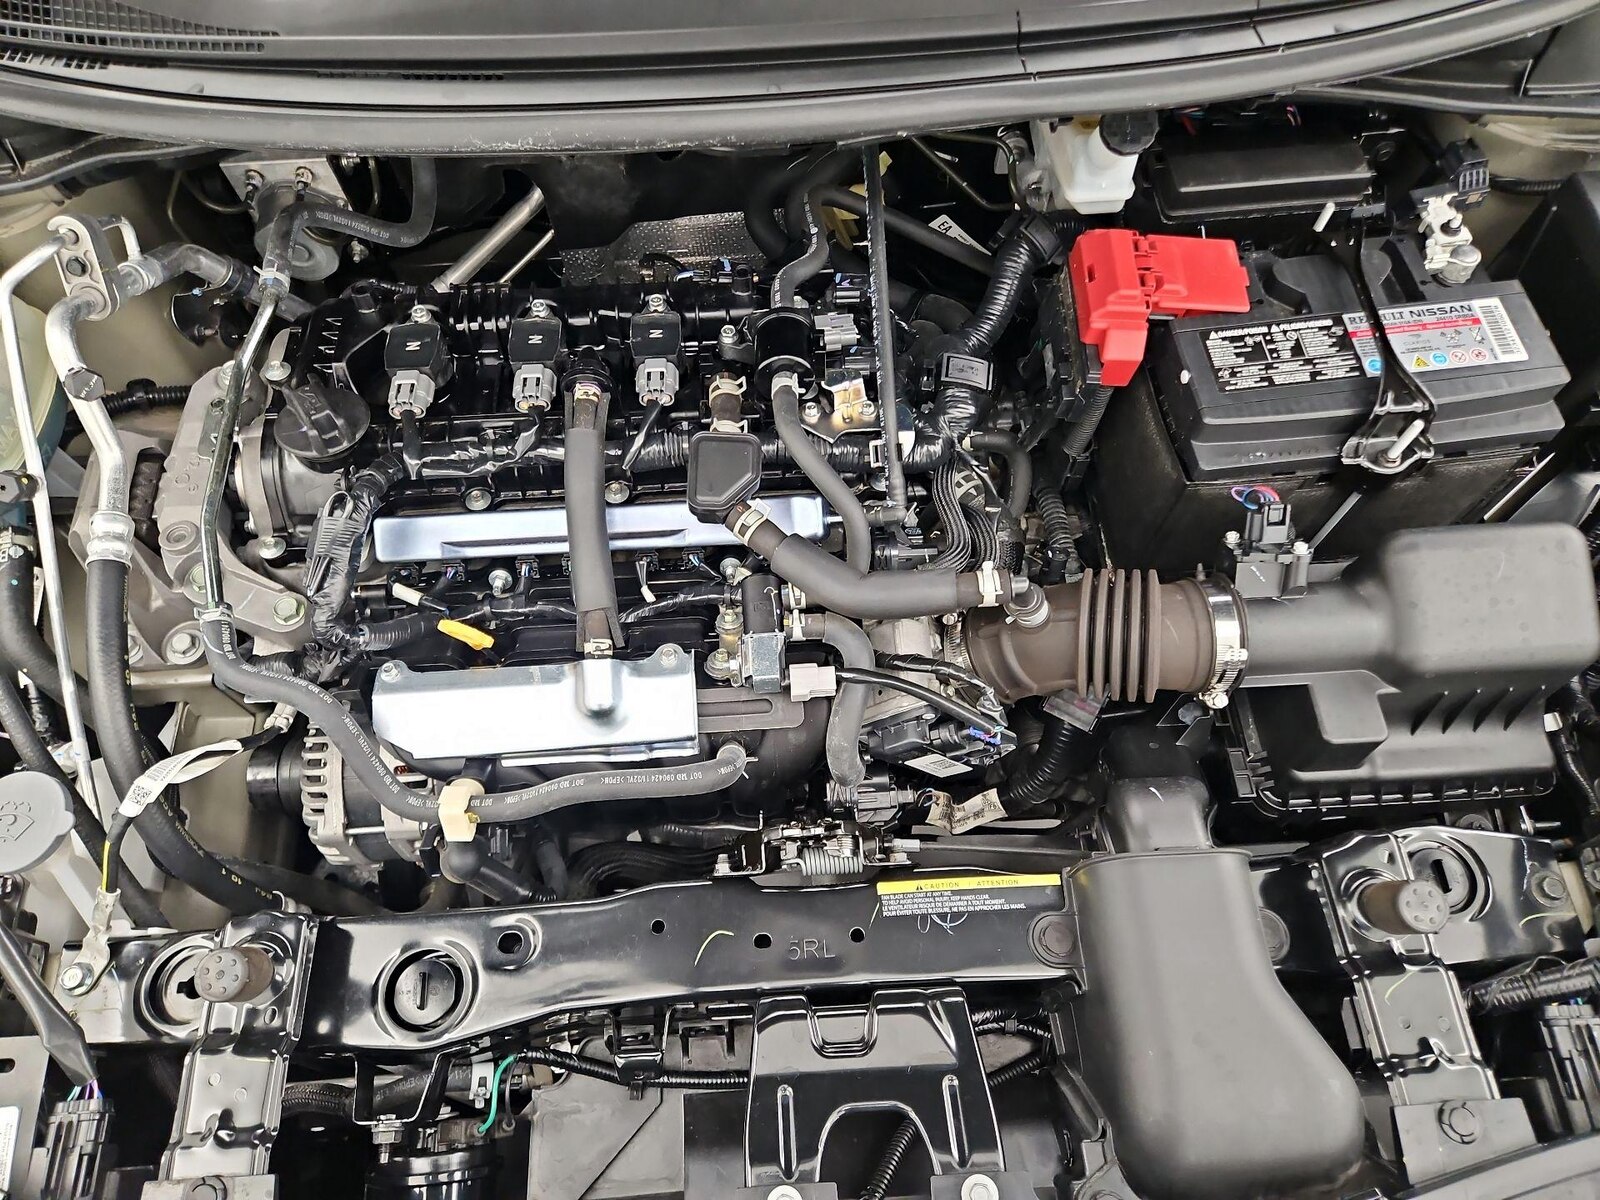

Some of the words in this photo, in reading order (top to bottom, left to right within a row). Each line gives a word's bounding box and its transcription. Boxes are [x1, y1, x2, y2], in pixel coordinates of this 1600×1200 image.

[937, 220, 953, 234] EA
[1349, 310, 1405, 326] REULT
[1409, 304, 1474, 318] NISSAN
[651, 773, 674, 782] 090424
[690, 771, 703, 780] DOT
[571, 778, 585, 787] DOT
[481, 798, 494, 806] DOT
[924, 882, 960, 890] CAUTION
[976, 879, 1019, 887] ATTENTION
[974, 904, 1001, 912] APPROCHER
[789, 938, 836, 960] 5RL
